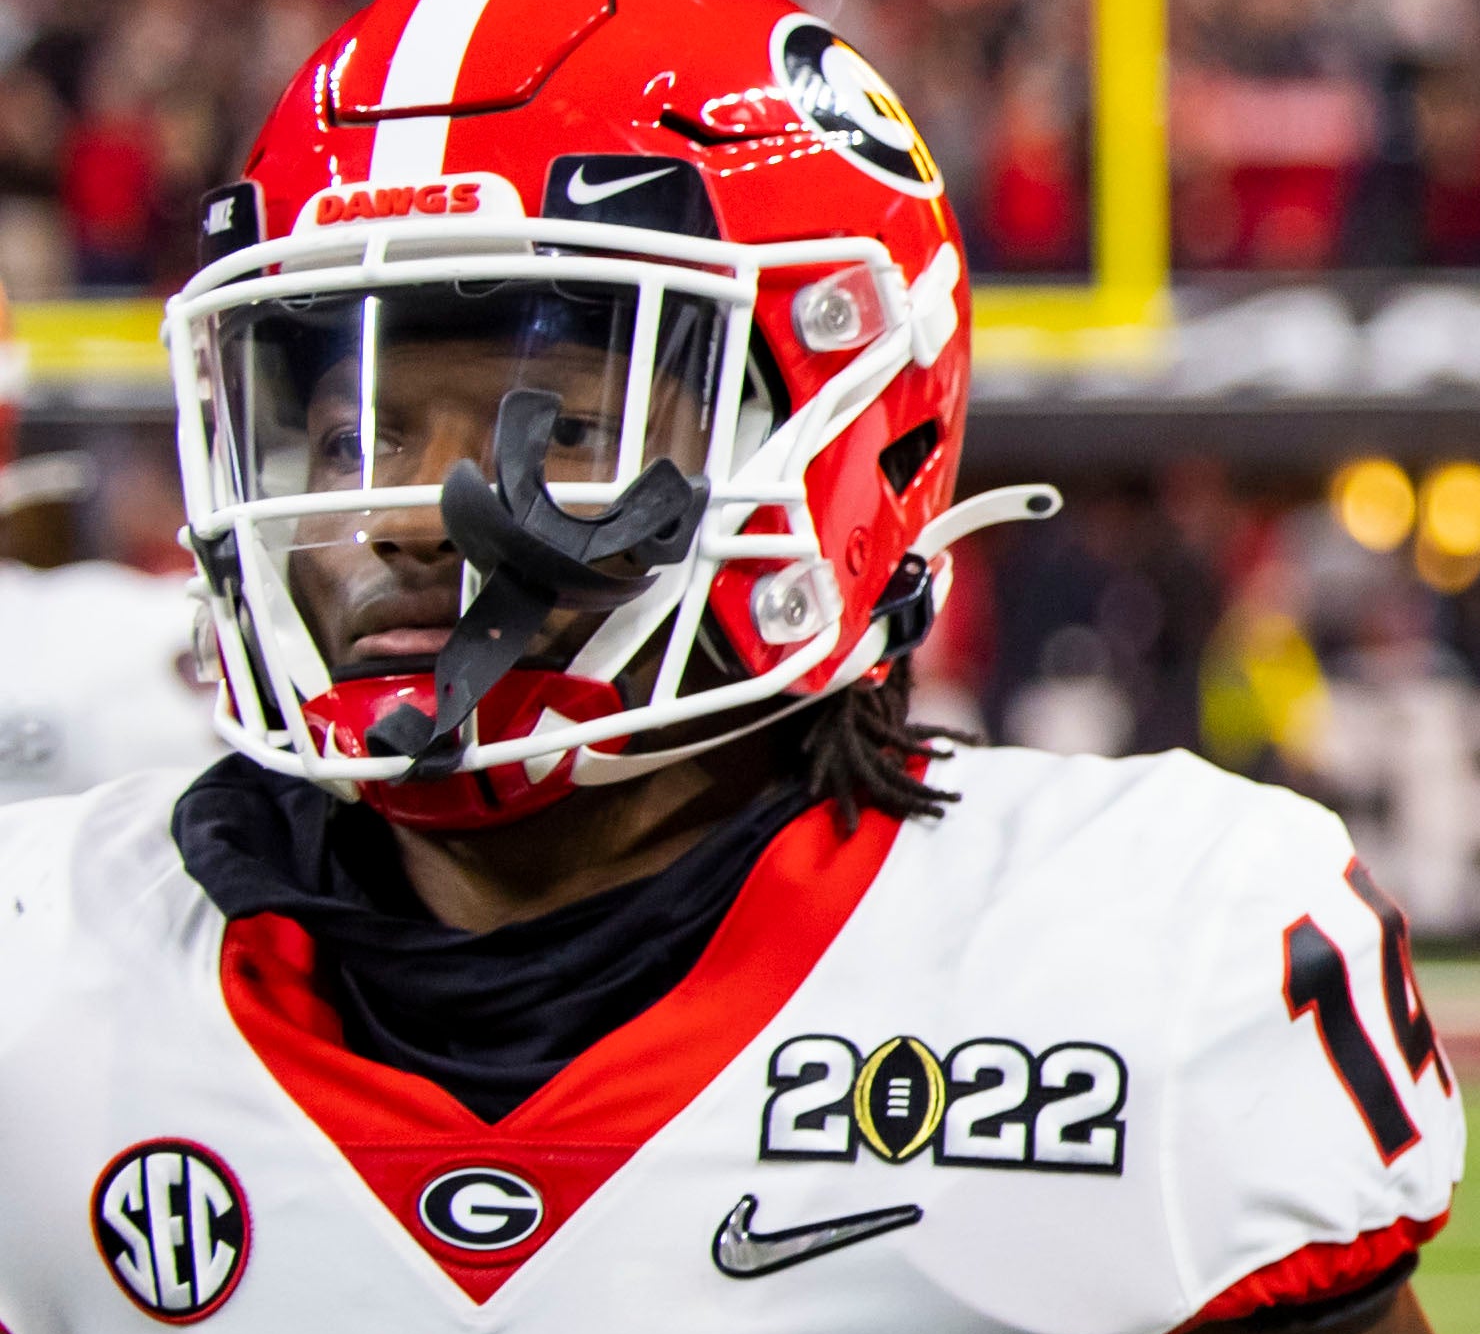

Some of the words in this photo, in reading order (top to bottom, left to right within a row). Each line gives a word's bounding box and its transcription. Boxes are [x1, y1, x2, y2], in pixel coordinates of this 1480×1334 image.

[315, 183, 481, 226] DAWGS
[101, 1151, 238, 1311] SEC
[421, 1170, 541, 1247] G
